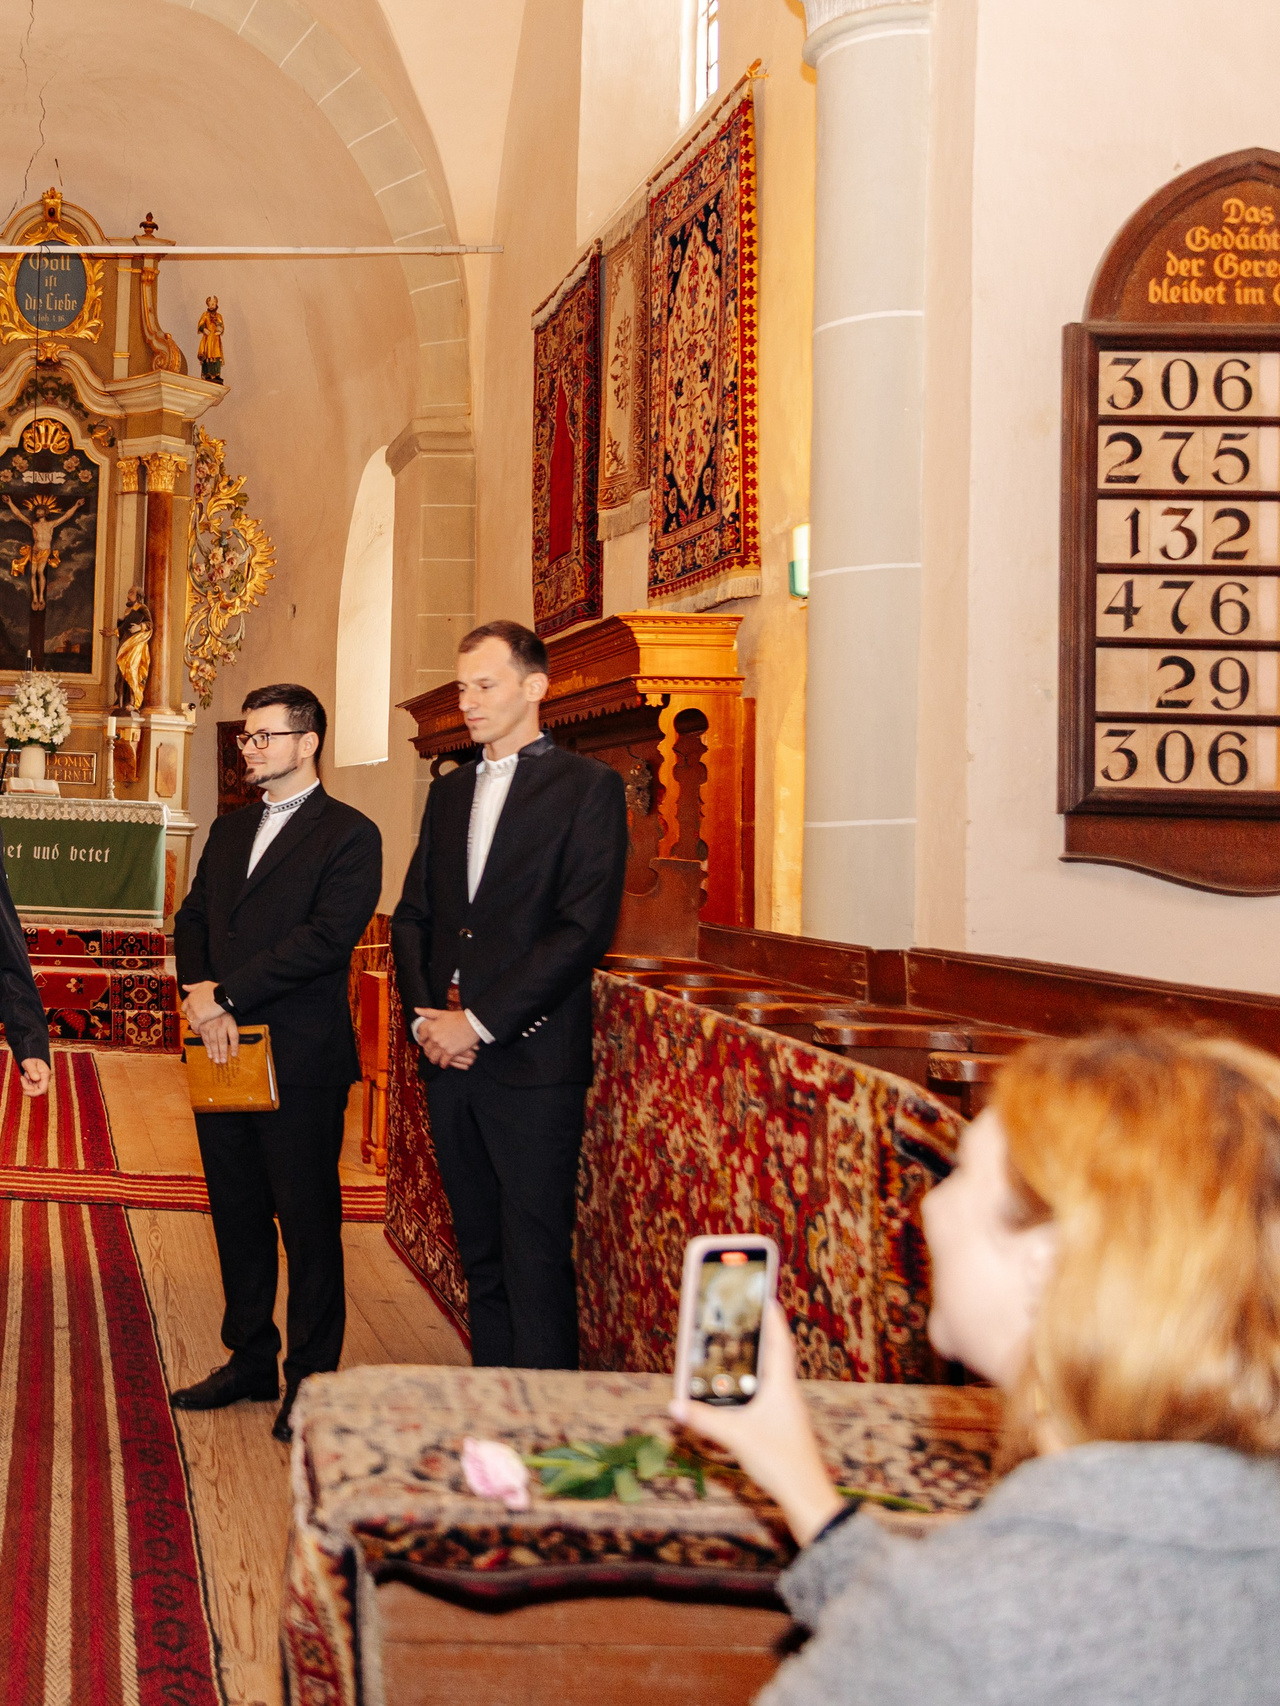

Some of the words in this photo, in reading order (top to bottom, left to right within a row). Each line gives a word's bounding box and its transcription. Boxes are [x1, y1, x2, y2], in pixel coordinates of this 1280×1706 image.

[1222, 198, 1275, 226] Das
[1148, 278, 1227, 305] bleibet
[1235, 279, 1266, 305] im
[1166, 250, 1206, 277] der
[1213, 252, 1280, 279] Gere
[46, 292, 78, 310] Liebe
[1106, 357, 1253, 412] 306
[1103, 431, 1251, 485] 275
[1124, 506, 1251, 561] 132
[1103, 578, 1251, 636] 476
[1155, 655, 1250, 711] 29
[1100, 728, 1249, 786] 306
[3, 842, 23, 859] et
[33, 843, 60, 860] und
[69, 845, 111, 863] betet
